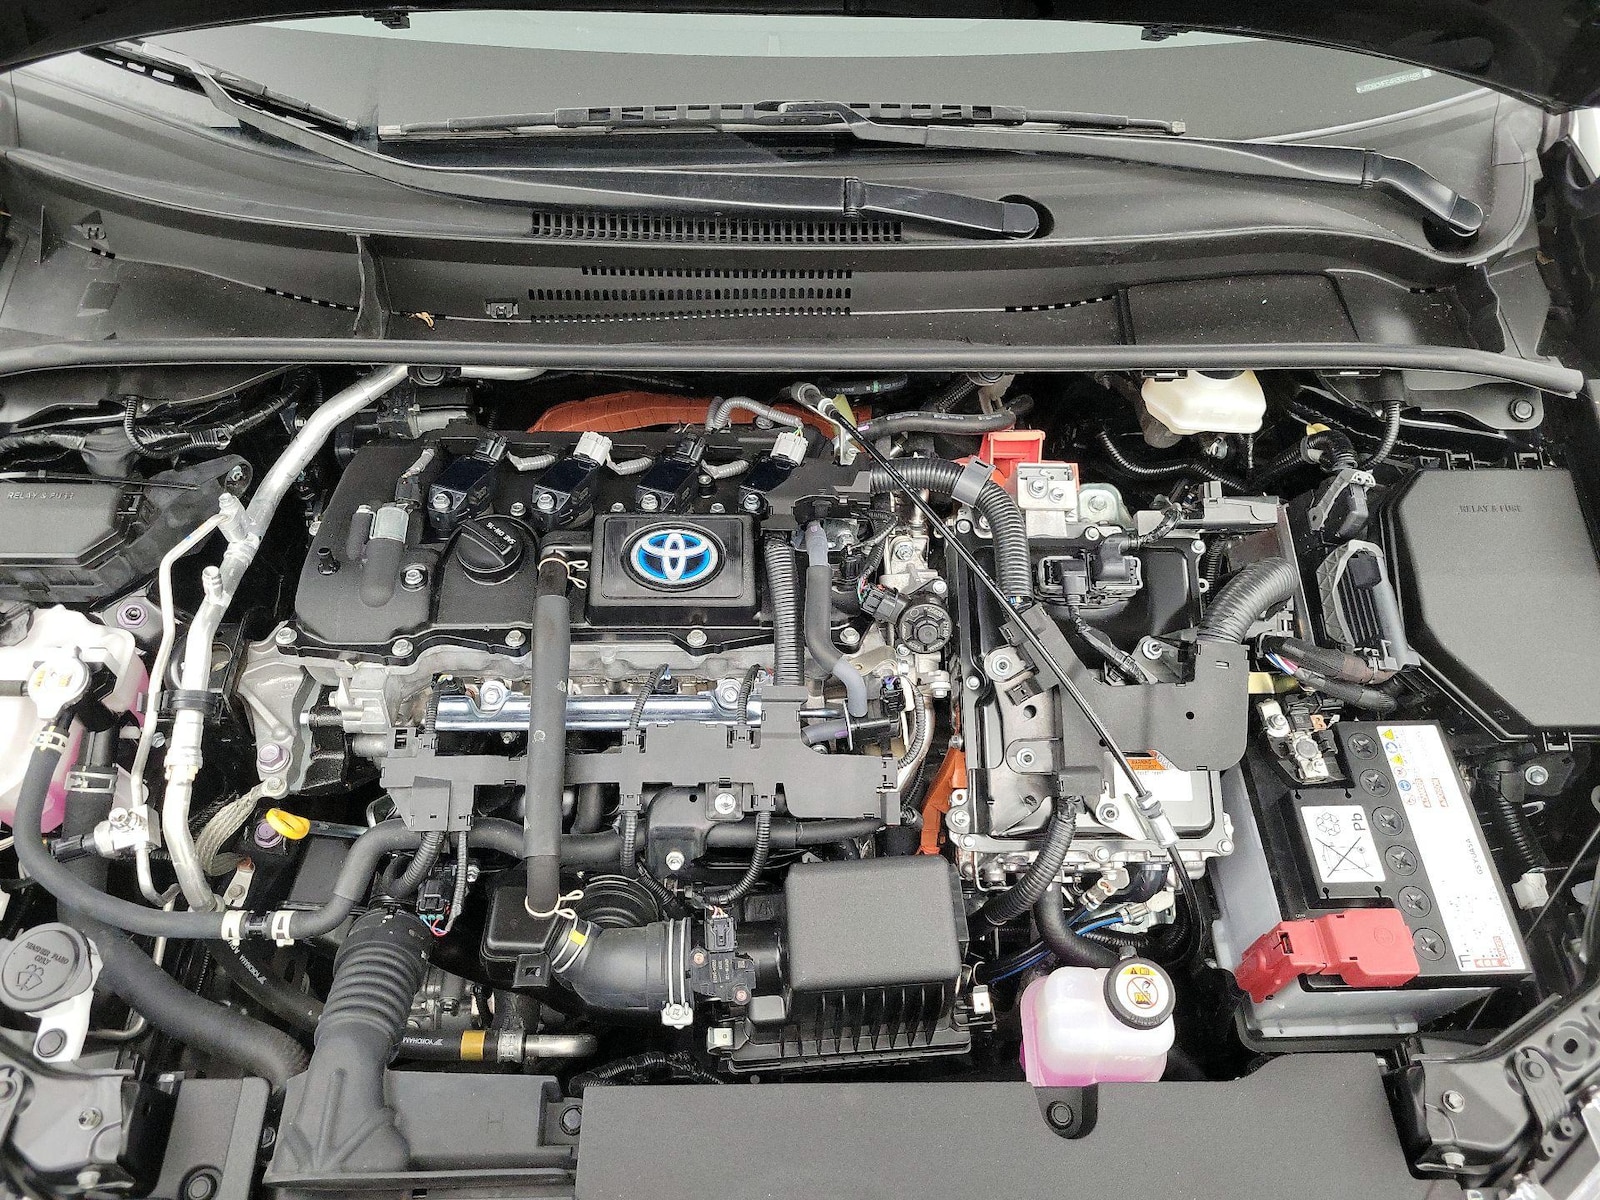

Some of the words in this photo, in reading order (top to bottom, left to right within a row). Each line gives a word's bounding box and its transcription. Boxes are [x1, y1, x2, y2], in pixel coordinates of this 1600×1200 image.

[503, 534, 517, 545] SAE
[1351, 812, 1366, 831] Pb
[402, 1036, 433, 1046] YOKOHAM
